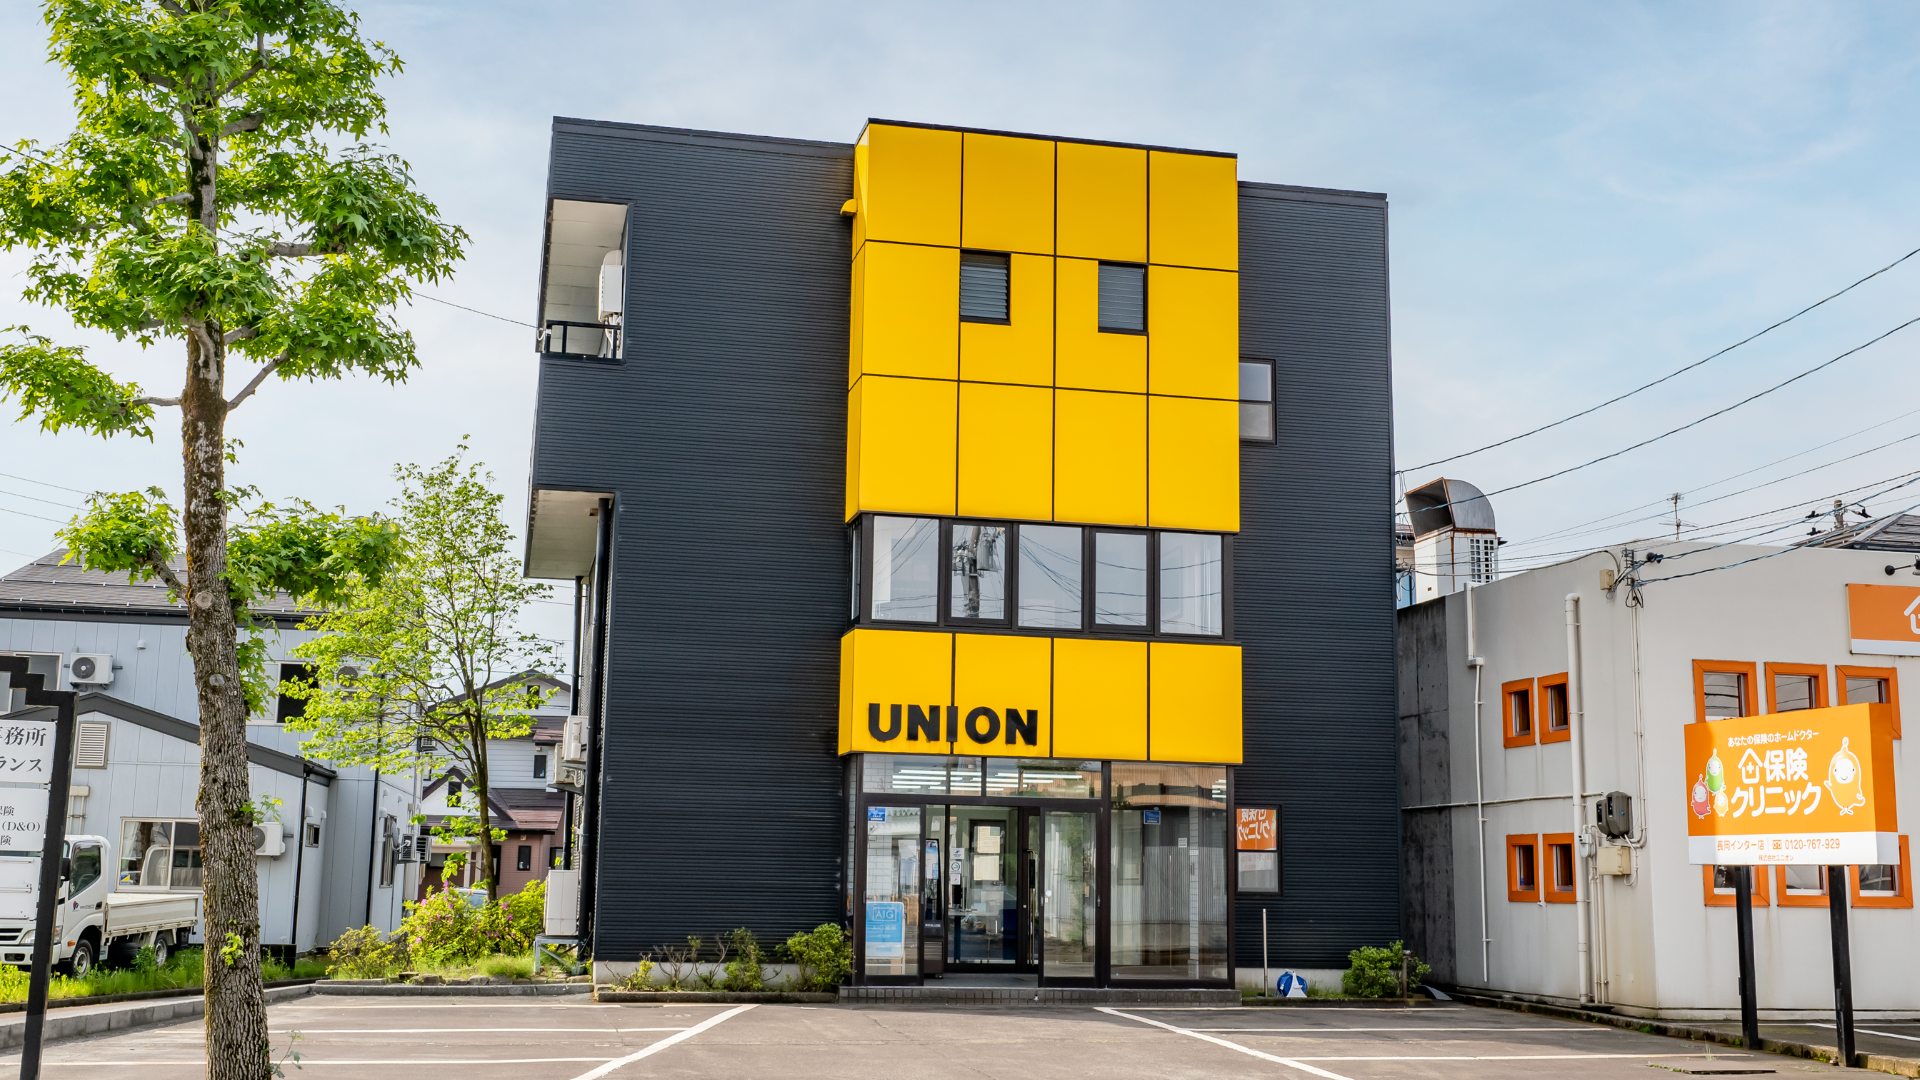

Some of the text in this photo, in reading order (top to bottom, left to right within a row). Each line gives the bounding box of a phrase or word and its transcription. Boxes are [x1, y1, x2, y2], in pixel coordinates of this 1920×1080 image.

[868, 703, 1038, 746] UNION
[0, 726, 47, 747] 務所
[1728, 729, 1819, 747] あなたの保険のホームドクター
[1764, 747, 1809, 782] 保険
[1731, 782, 1821, 818] クリニック
[0, 805, 15, 817] 険
[2, 821, 41, 832] (D&O)
[1717, 838, 1840, 851] 長岡インター店 0120-767-929
[875, 910, 894, 919] AIG
